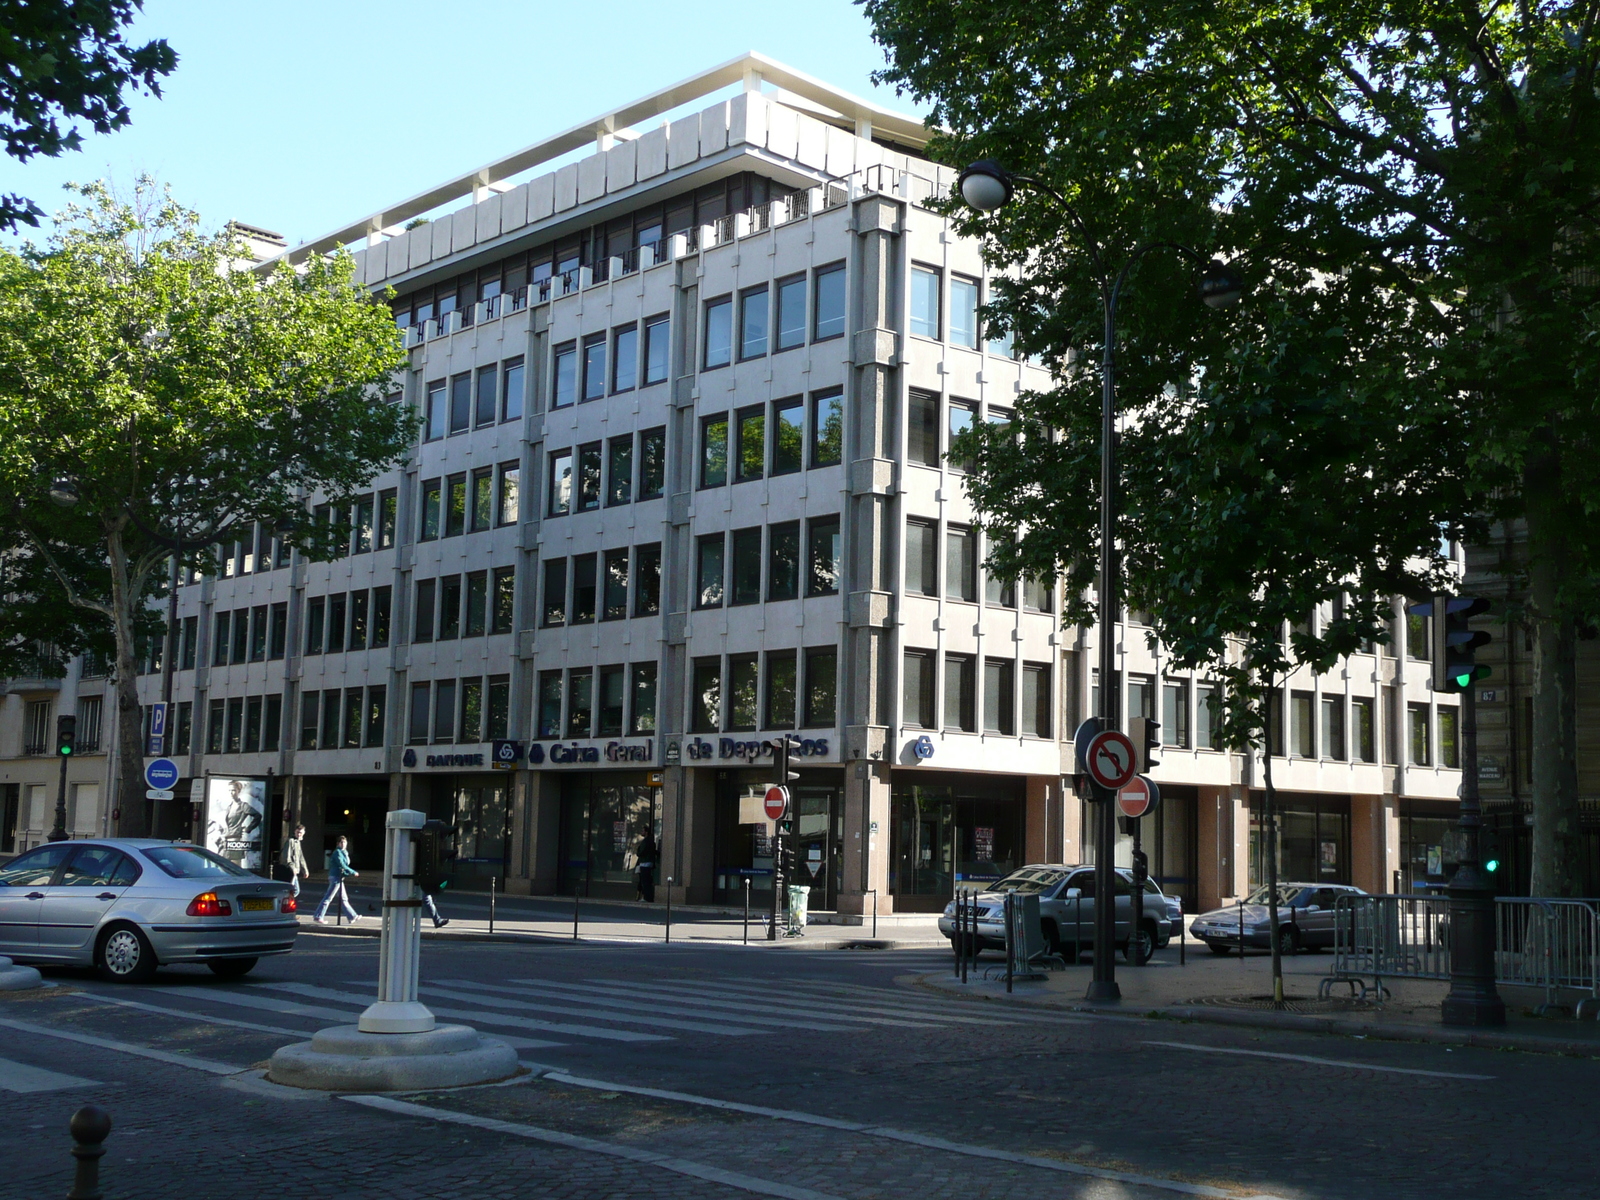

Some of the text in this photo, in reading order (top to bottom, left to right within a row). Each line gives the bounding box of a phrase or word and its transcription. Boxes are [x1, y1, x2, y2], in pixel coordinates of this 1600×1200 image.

[1482, 692, 1494, 701] 87
[154, 709, 163, 730] P
[549, 742, 599, 763] Caixa
[603, 739, 653, 762] Geral
[686, 737, 713, 759] de
[426, 754, 484, 767] BANQUE
